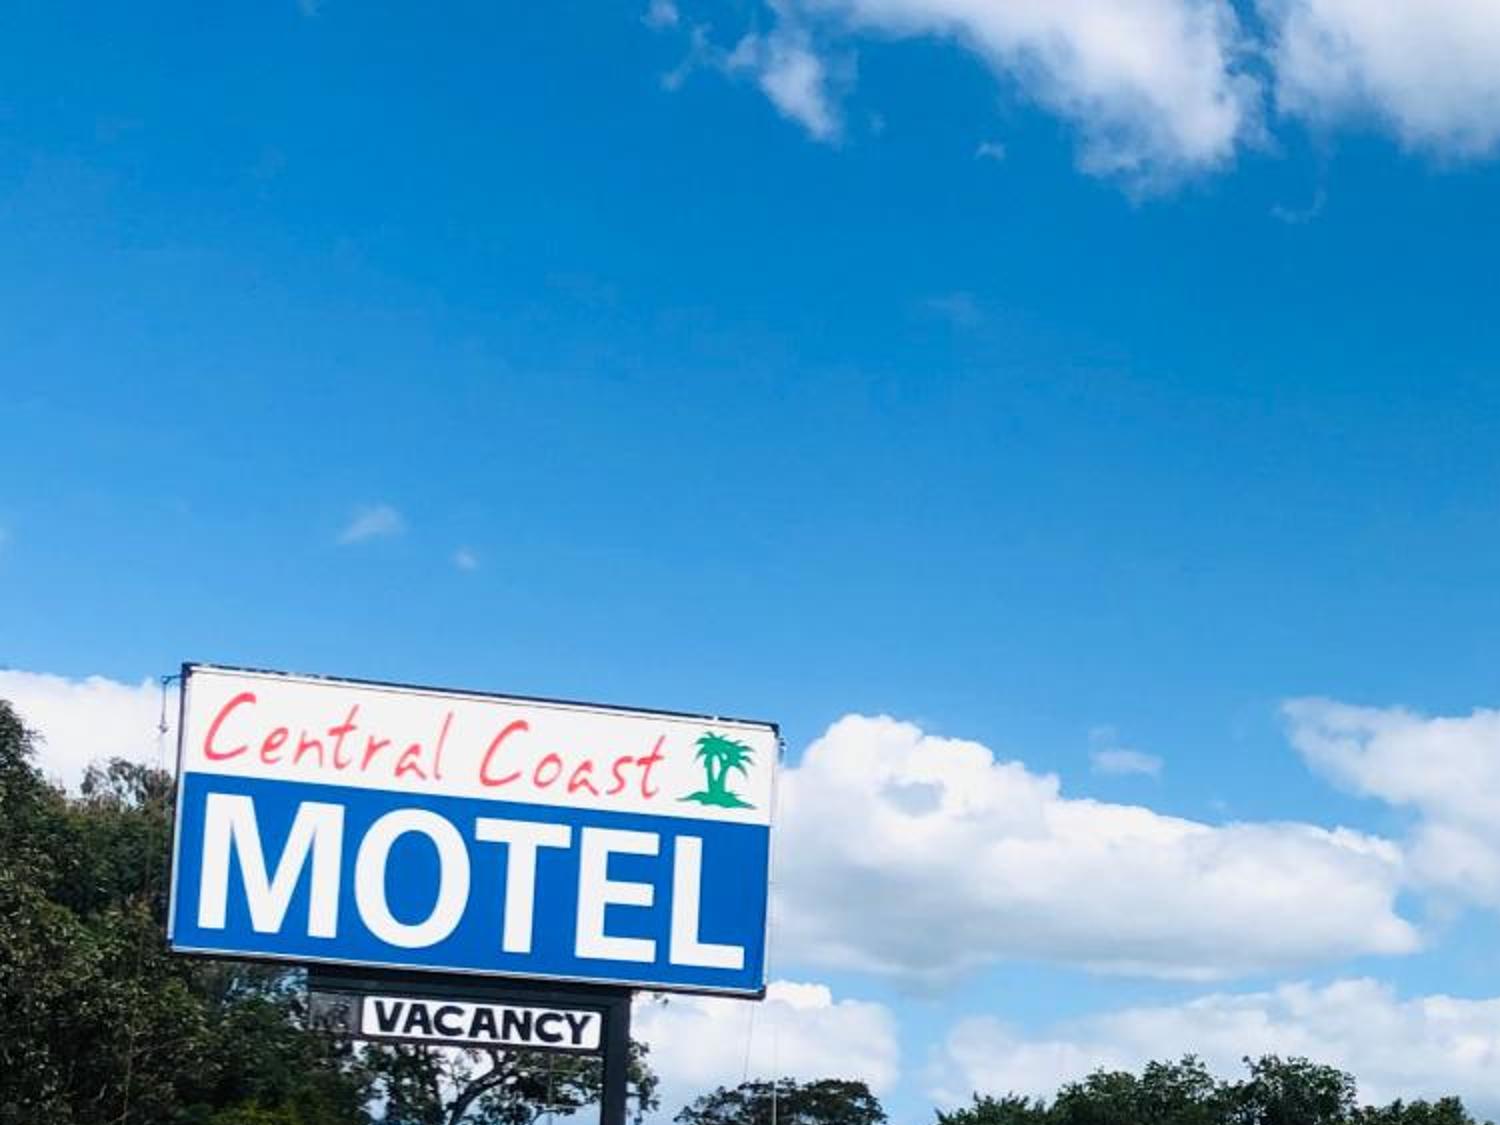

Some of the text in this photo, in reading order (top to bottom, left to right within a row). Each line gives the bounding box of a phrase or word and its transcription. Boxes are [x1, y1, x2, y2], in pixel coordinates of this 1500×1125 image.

[203, 691, 666, 799] Central Coast
[198, 792, 745, 970] MOTEL
[374, 1001, 592, 1045] VACANCY
